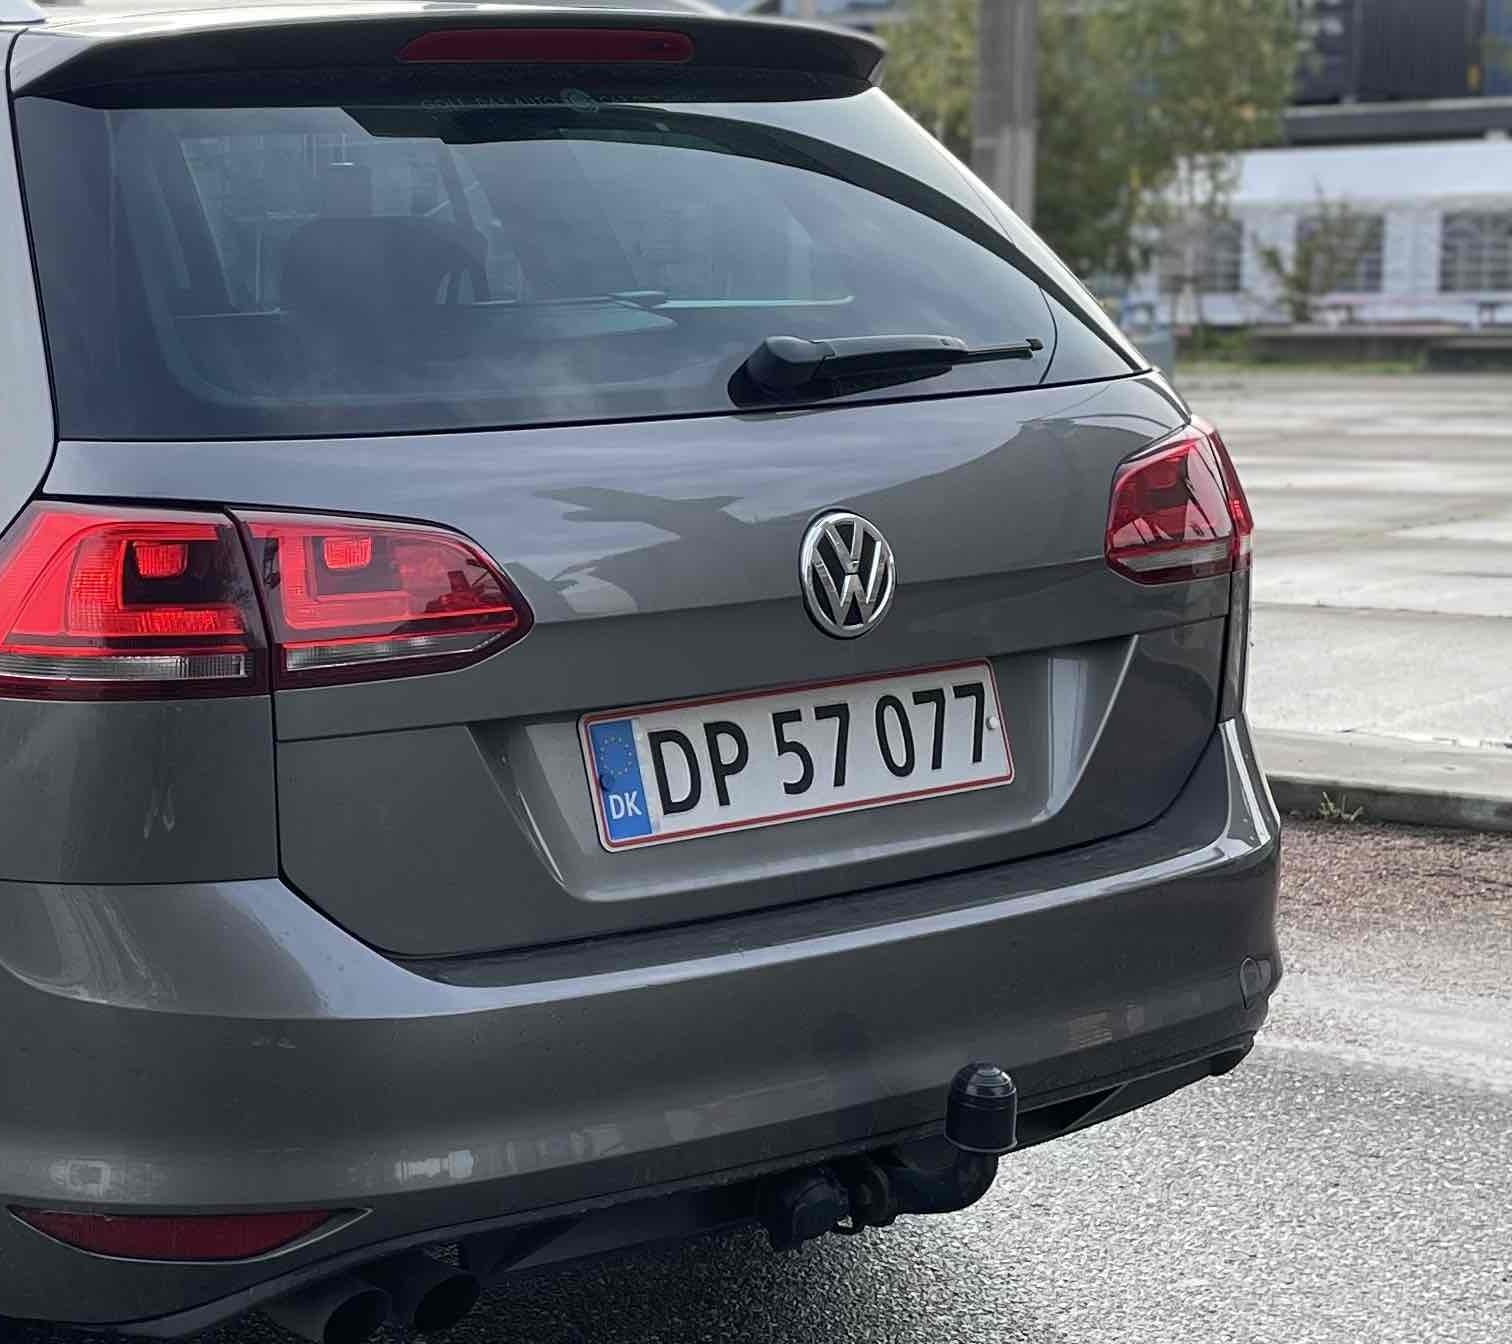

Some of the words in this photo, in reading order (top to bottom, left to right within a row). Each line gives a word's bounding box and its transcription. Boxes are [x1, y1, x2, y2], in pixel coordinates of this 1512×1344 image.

[648, 721, 749, 816] DP
[771, 702, 850, 796] 57
[874, 682, 986, 779] 077
[607, 791, 643, 820] DK
